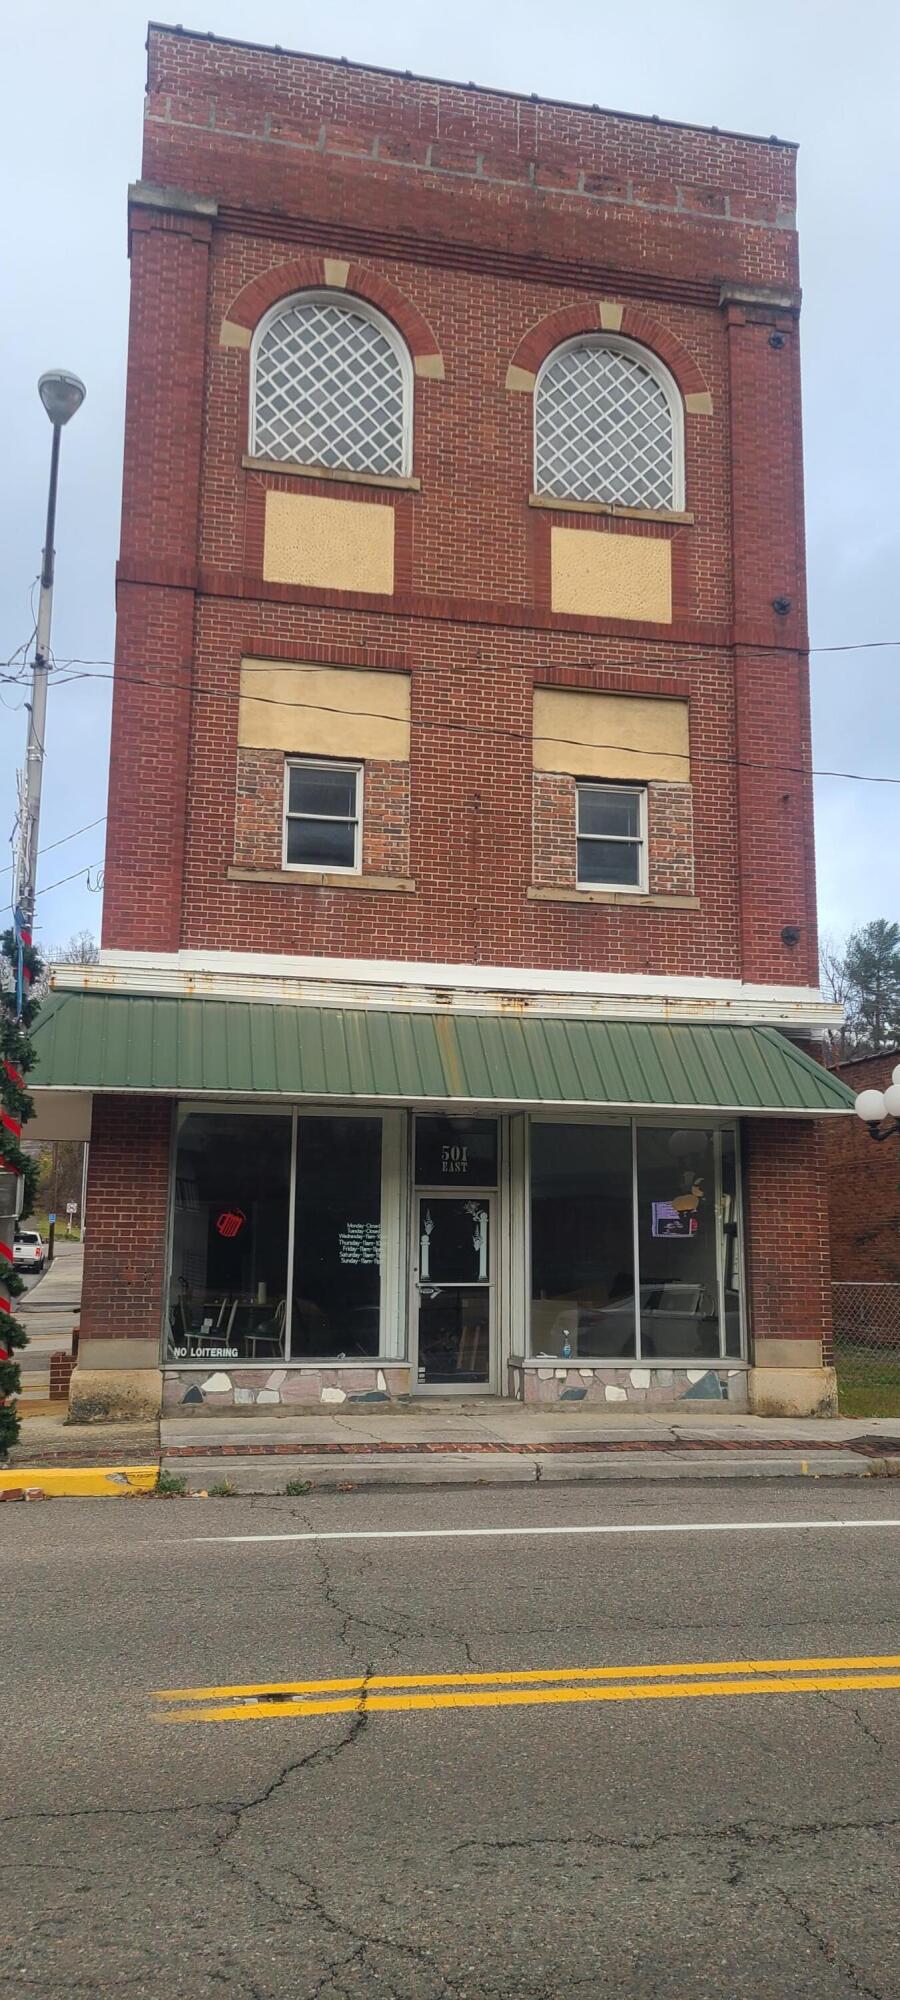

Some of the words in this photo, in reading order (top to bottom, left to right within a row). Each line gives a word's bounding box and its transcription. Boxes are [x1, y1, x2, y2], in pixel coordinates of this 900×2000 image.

[441, 1145, 468, 1161] 501
[442, 1161, 468, 1172] EAST
[173, 1347, 187, 1357] NO
[190, 1347, 239, 1357] LOITERING
